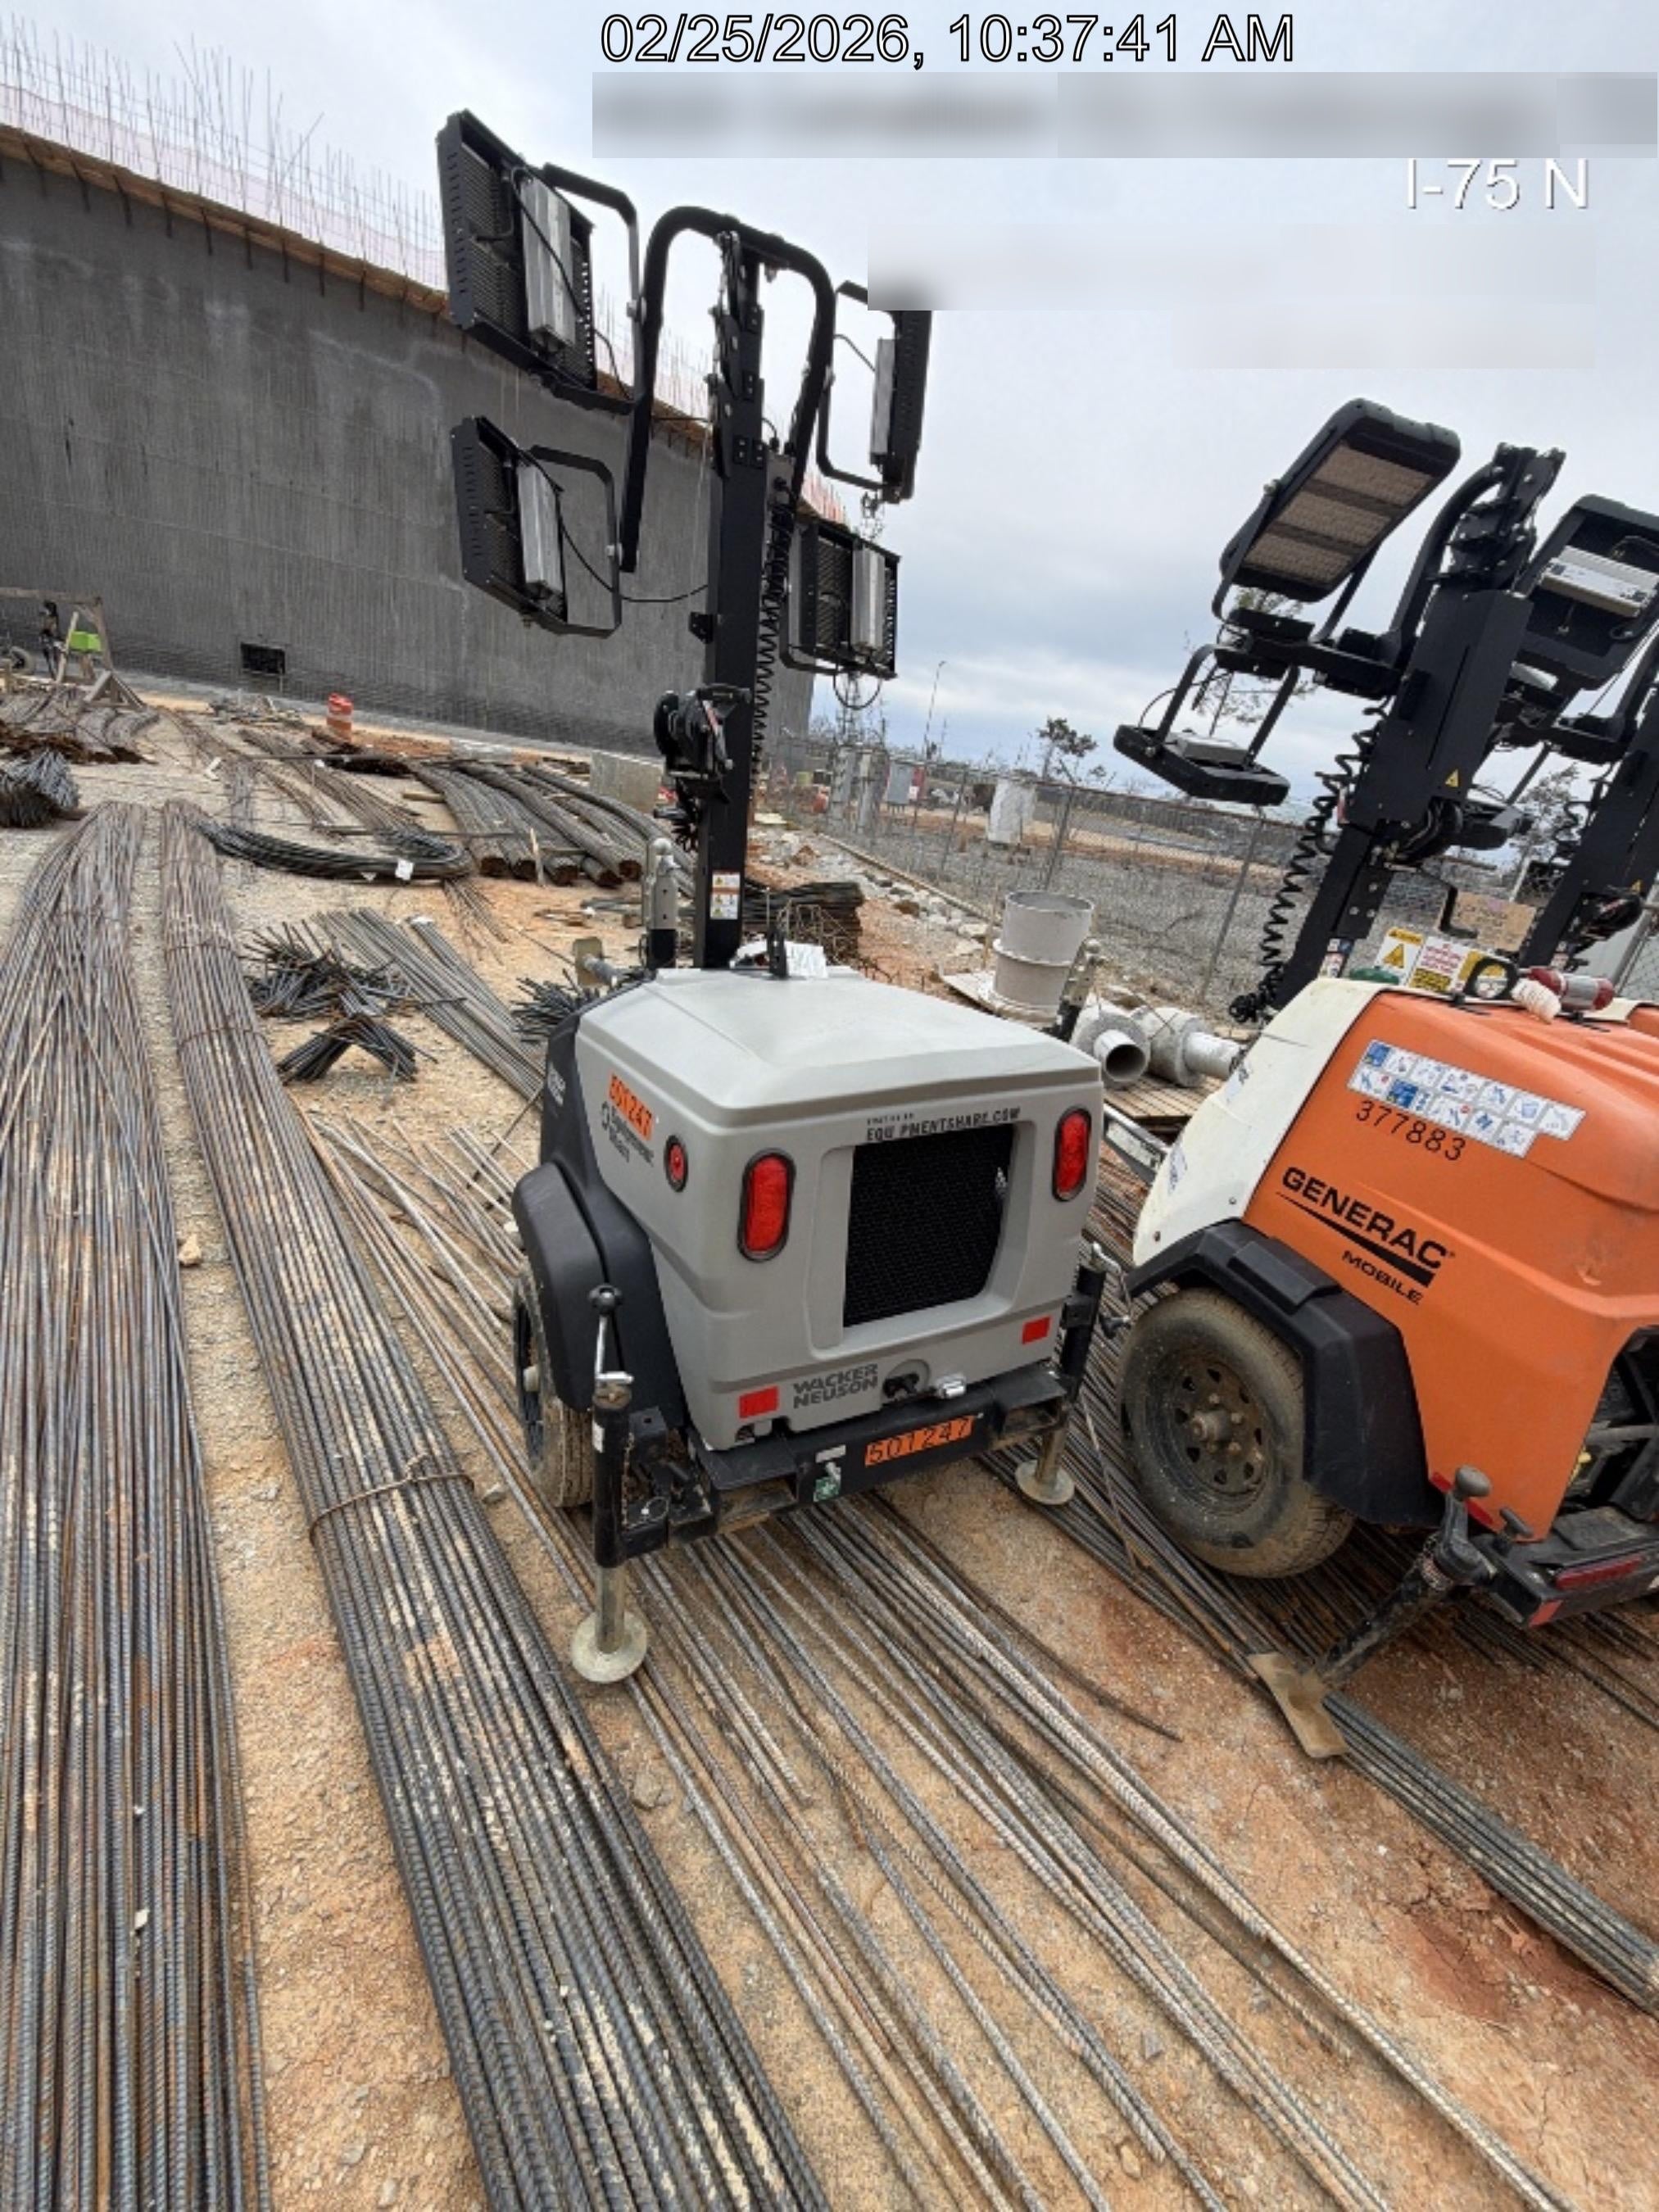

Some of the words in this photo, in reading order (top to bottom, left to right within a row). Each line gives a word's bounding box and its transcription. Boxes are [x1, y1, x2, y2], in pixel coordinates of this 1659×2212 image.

[866, 1106, 1022, 1141] EQUPMENTSHARE.COM
[1356, 1099, 1466, 1161] 377883
[1281, 1166, 1448, 1270] GENERAC
[1341, 1249, 1424, 1306] MOBILE
[792, 1363, 878, 1394] WACKER
[792, 1376, 878, 1409] NEUSON
[868, 1416, 972, 1465] 501247
